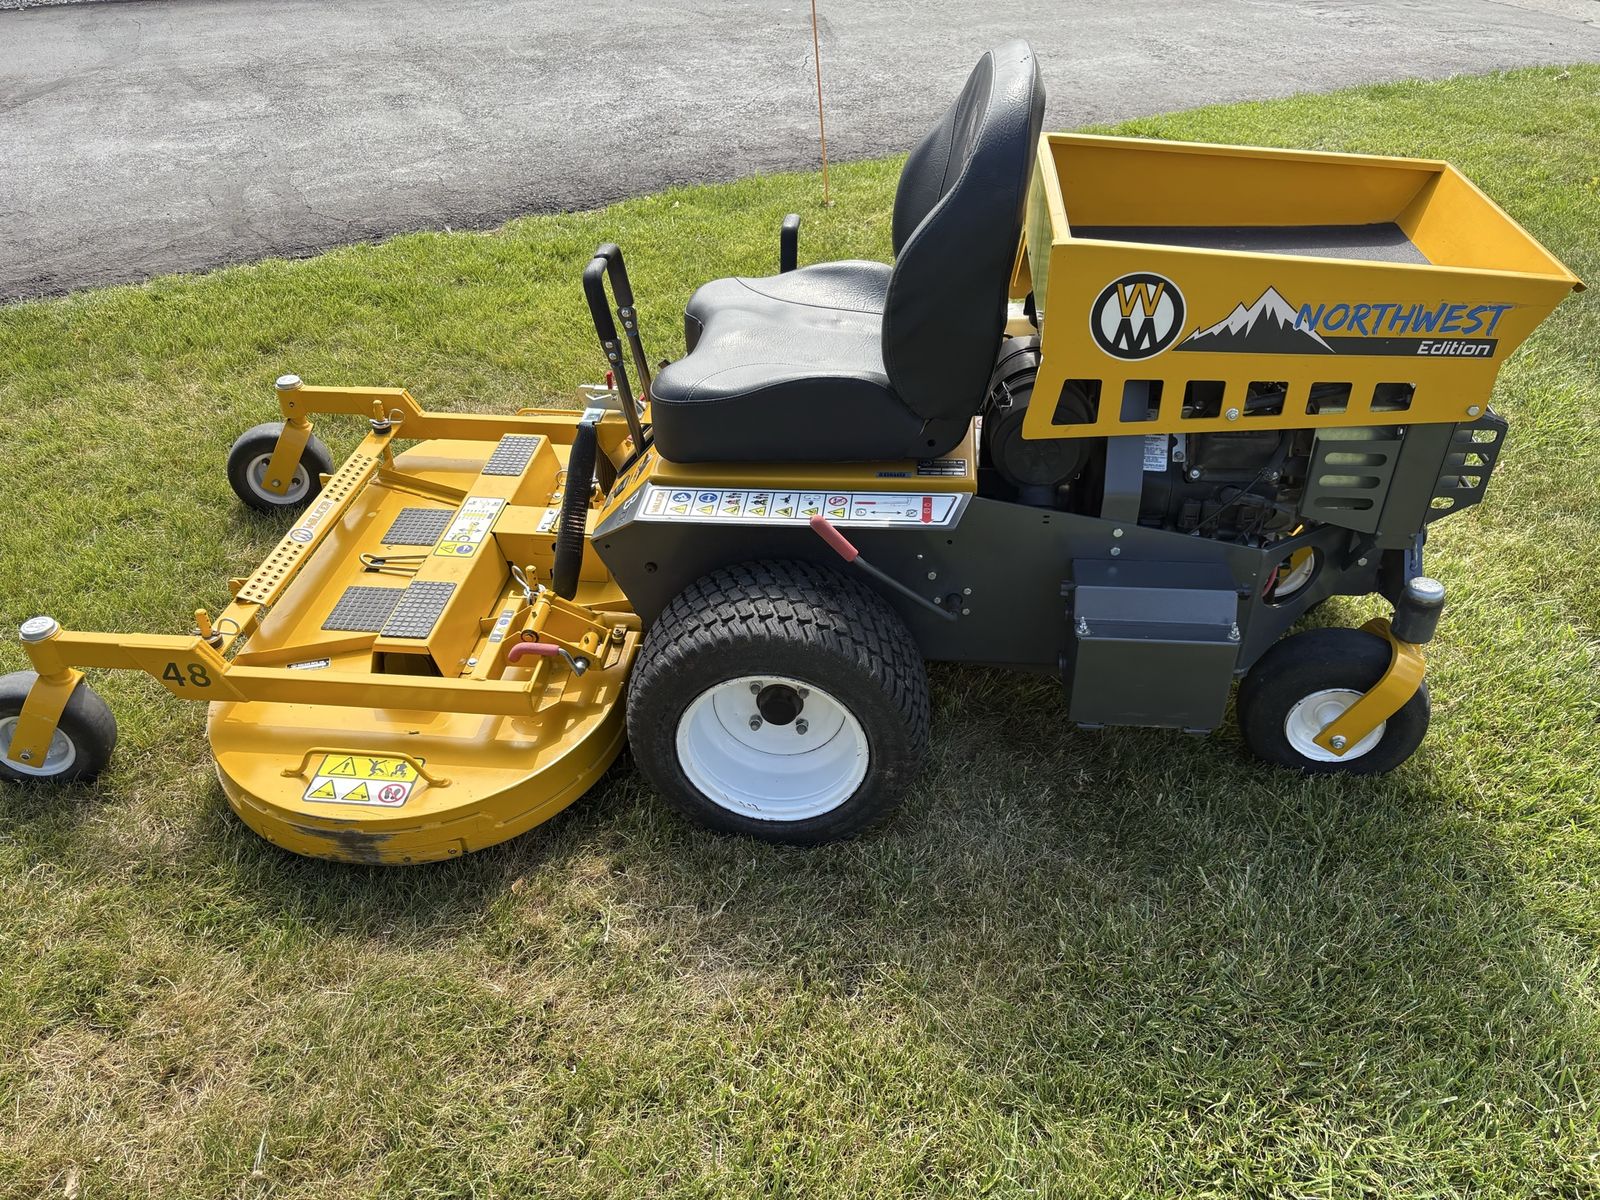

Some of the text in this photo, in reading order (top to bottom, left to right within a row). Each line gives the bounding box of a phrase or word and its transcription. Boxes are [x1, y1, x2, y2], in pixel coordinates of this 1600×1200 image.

[1294, 303, 1513, 336] NORTHWEST
[1416, 340, 1491, 356] Edition
[162, 662, 212, 688] 48
